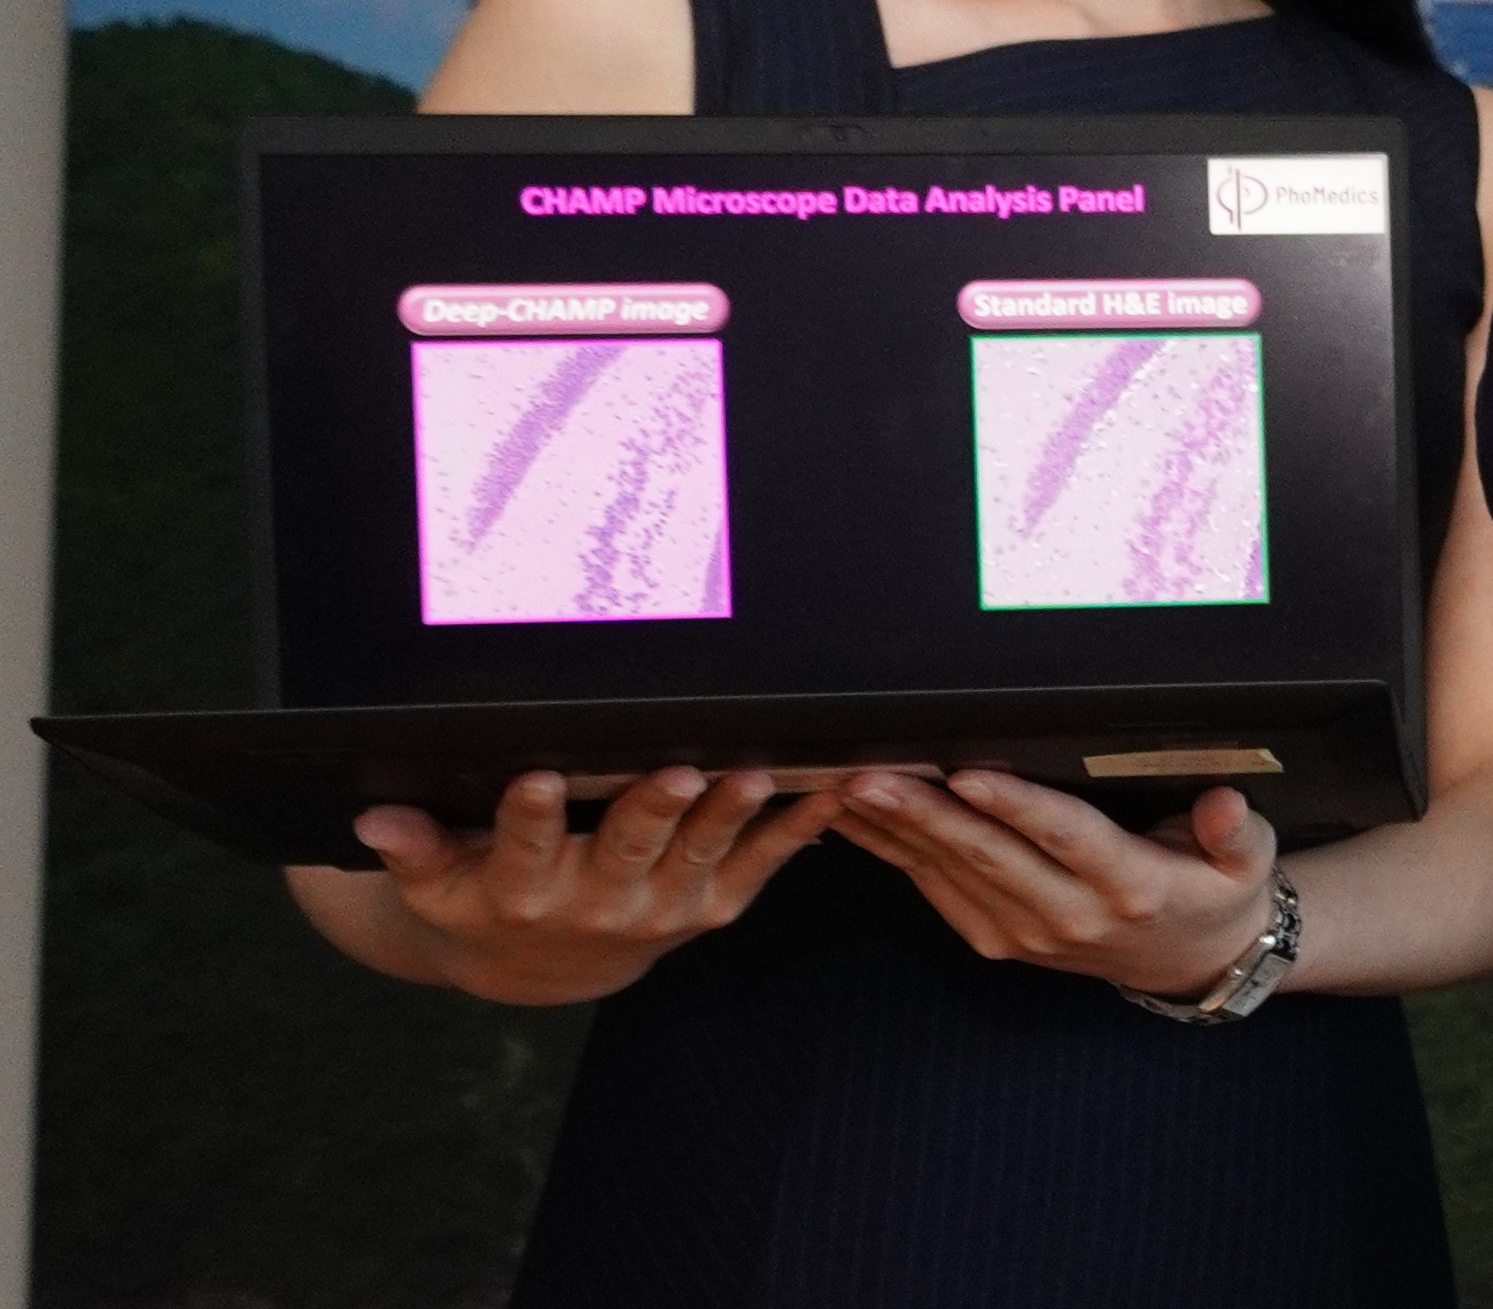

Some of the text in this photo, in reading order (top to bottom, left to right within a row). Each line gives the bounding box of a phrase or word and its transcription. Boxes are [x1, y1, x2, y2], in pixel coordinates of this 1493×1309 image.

[520, 184, 1146, 220] CHAMP Microscope Data Analysis Panel
[1276, 185, 1379, 205] PhoMedics
[422, 297, 710, 328] Deep-CHAMP image
[973, 292, 1248, 320] Standard H&E image
